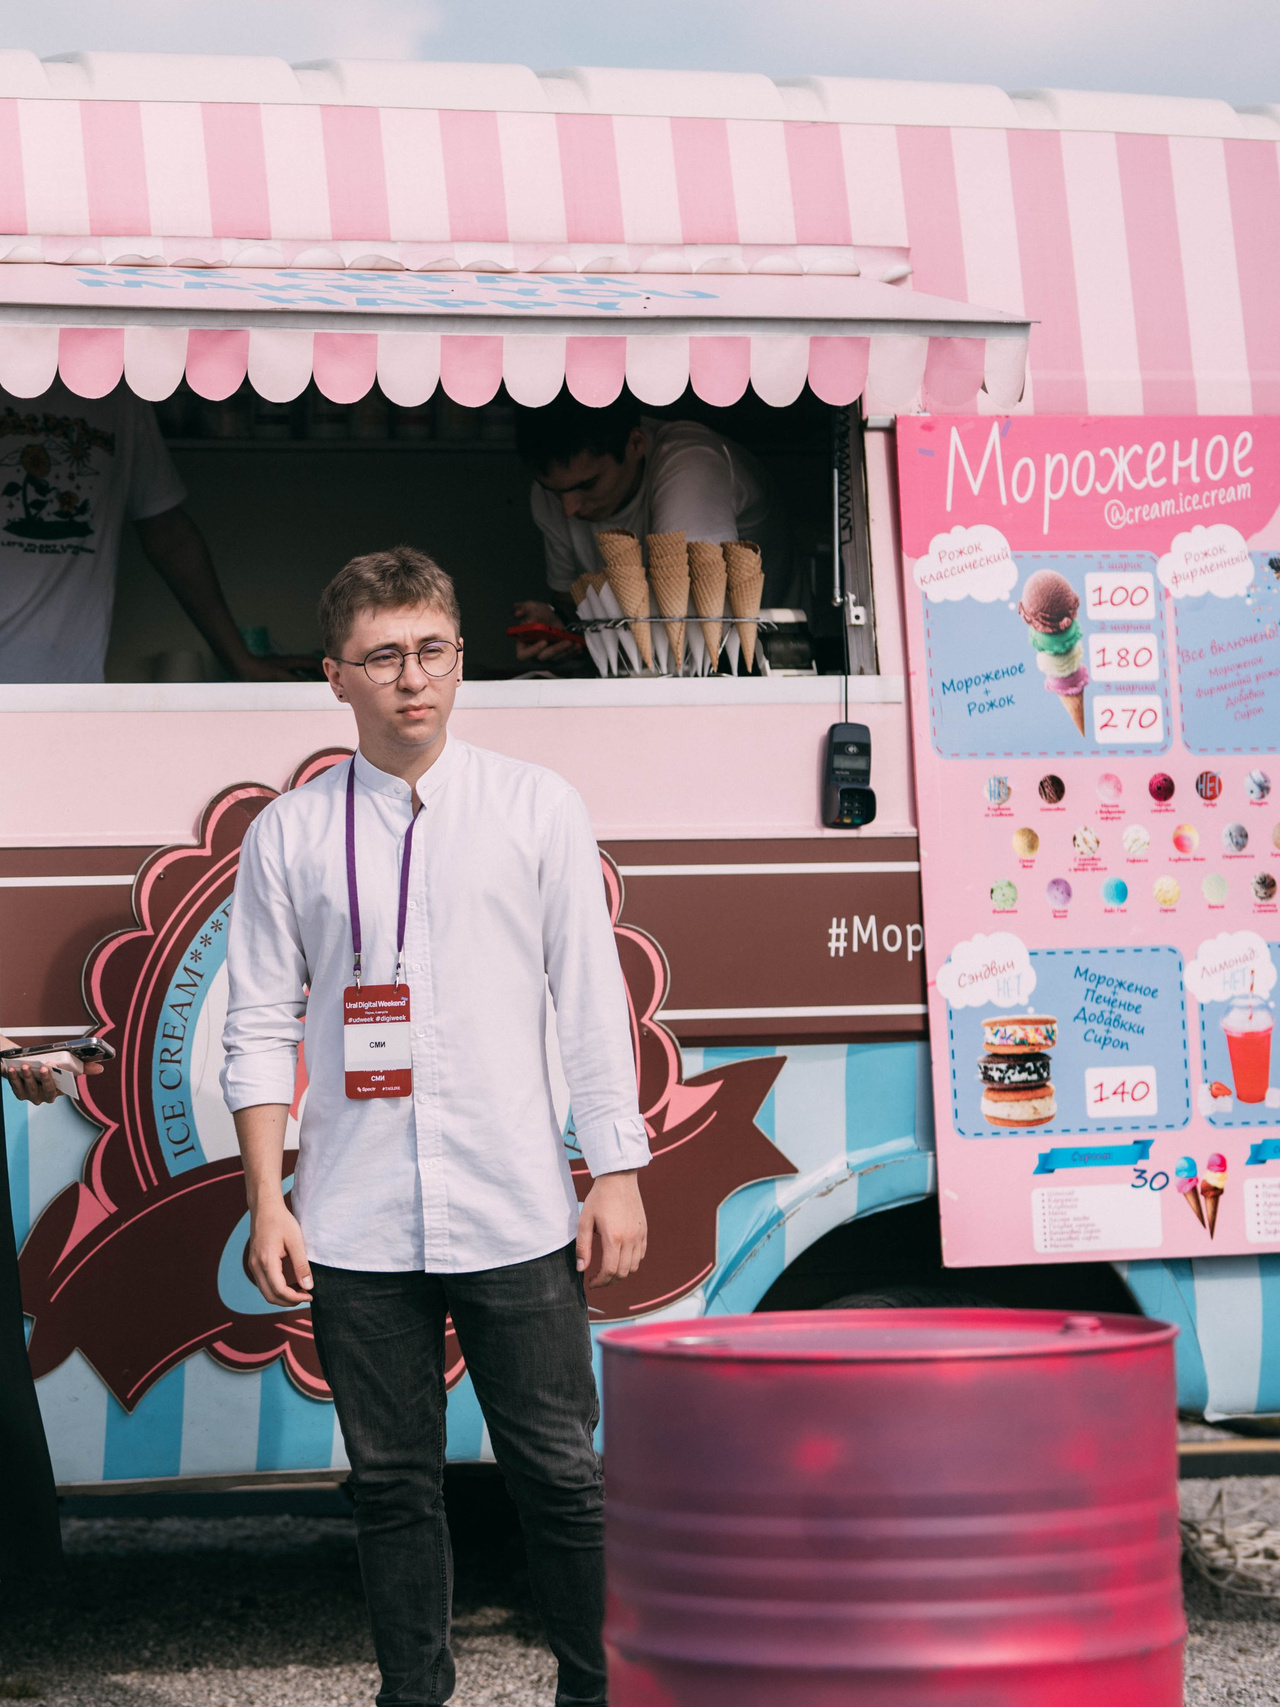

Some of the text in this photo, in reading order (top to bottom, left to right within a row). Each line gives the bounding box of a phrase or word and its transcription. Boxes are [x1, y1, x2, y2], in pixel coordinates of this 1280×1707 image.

[73, 267, 638, 286] ICE CREAM
[75, 279, 719, 299] MAKES YOU
[255, 295, 624, 311] HAPPY
[946, 421, 1254, 535] Мороженое
[1104, 482, 1251, 529] @cream.ice.cream
[938, 542, 983, 564] Рожок
[1184, 544, 1227, 565] Рожок
[920, 546, 1010, 586] классический
[1171, 549, 1248, 589] фирменный
[1092, 585, 1149, 607] 100
[1096, 647, 1153, 668] 180
[1181, 648, 1205, 664] Все
[942, 662, 1026, 696] Мороженое
[967, 694, 1016, 717] Рожок
[1100, 708, 1158, 730] 270
[1197, 771, 1222, 798] НЕТ
[828, 915, 924, 962] #Мор
[958, 960, 1015, 989] Сэндвич
[1074, 965, 1160, 999] Мороженое
[358, 1001, 377, 1010] Digital
[1084, 988, 1142, 1014] Печенье
[1073, 1007, 1145, 1036] Добавкки
[1084, 1029, 1130, 1051] Сироп
[1093, 1081, 1150, 1104] 140
[161, 1100, 196, 1160] ICE
[1131, 1168, 1170, 1192] 30
